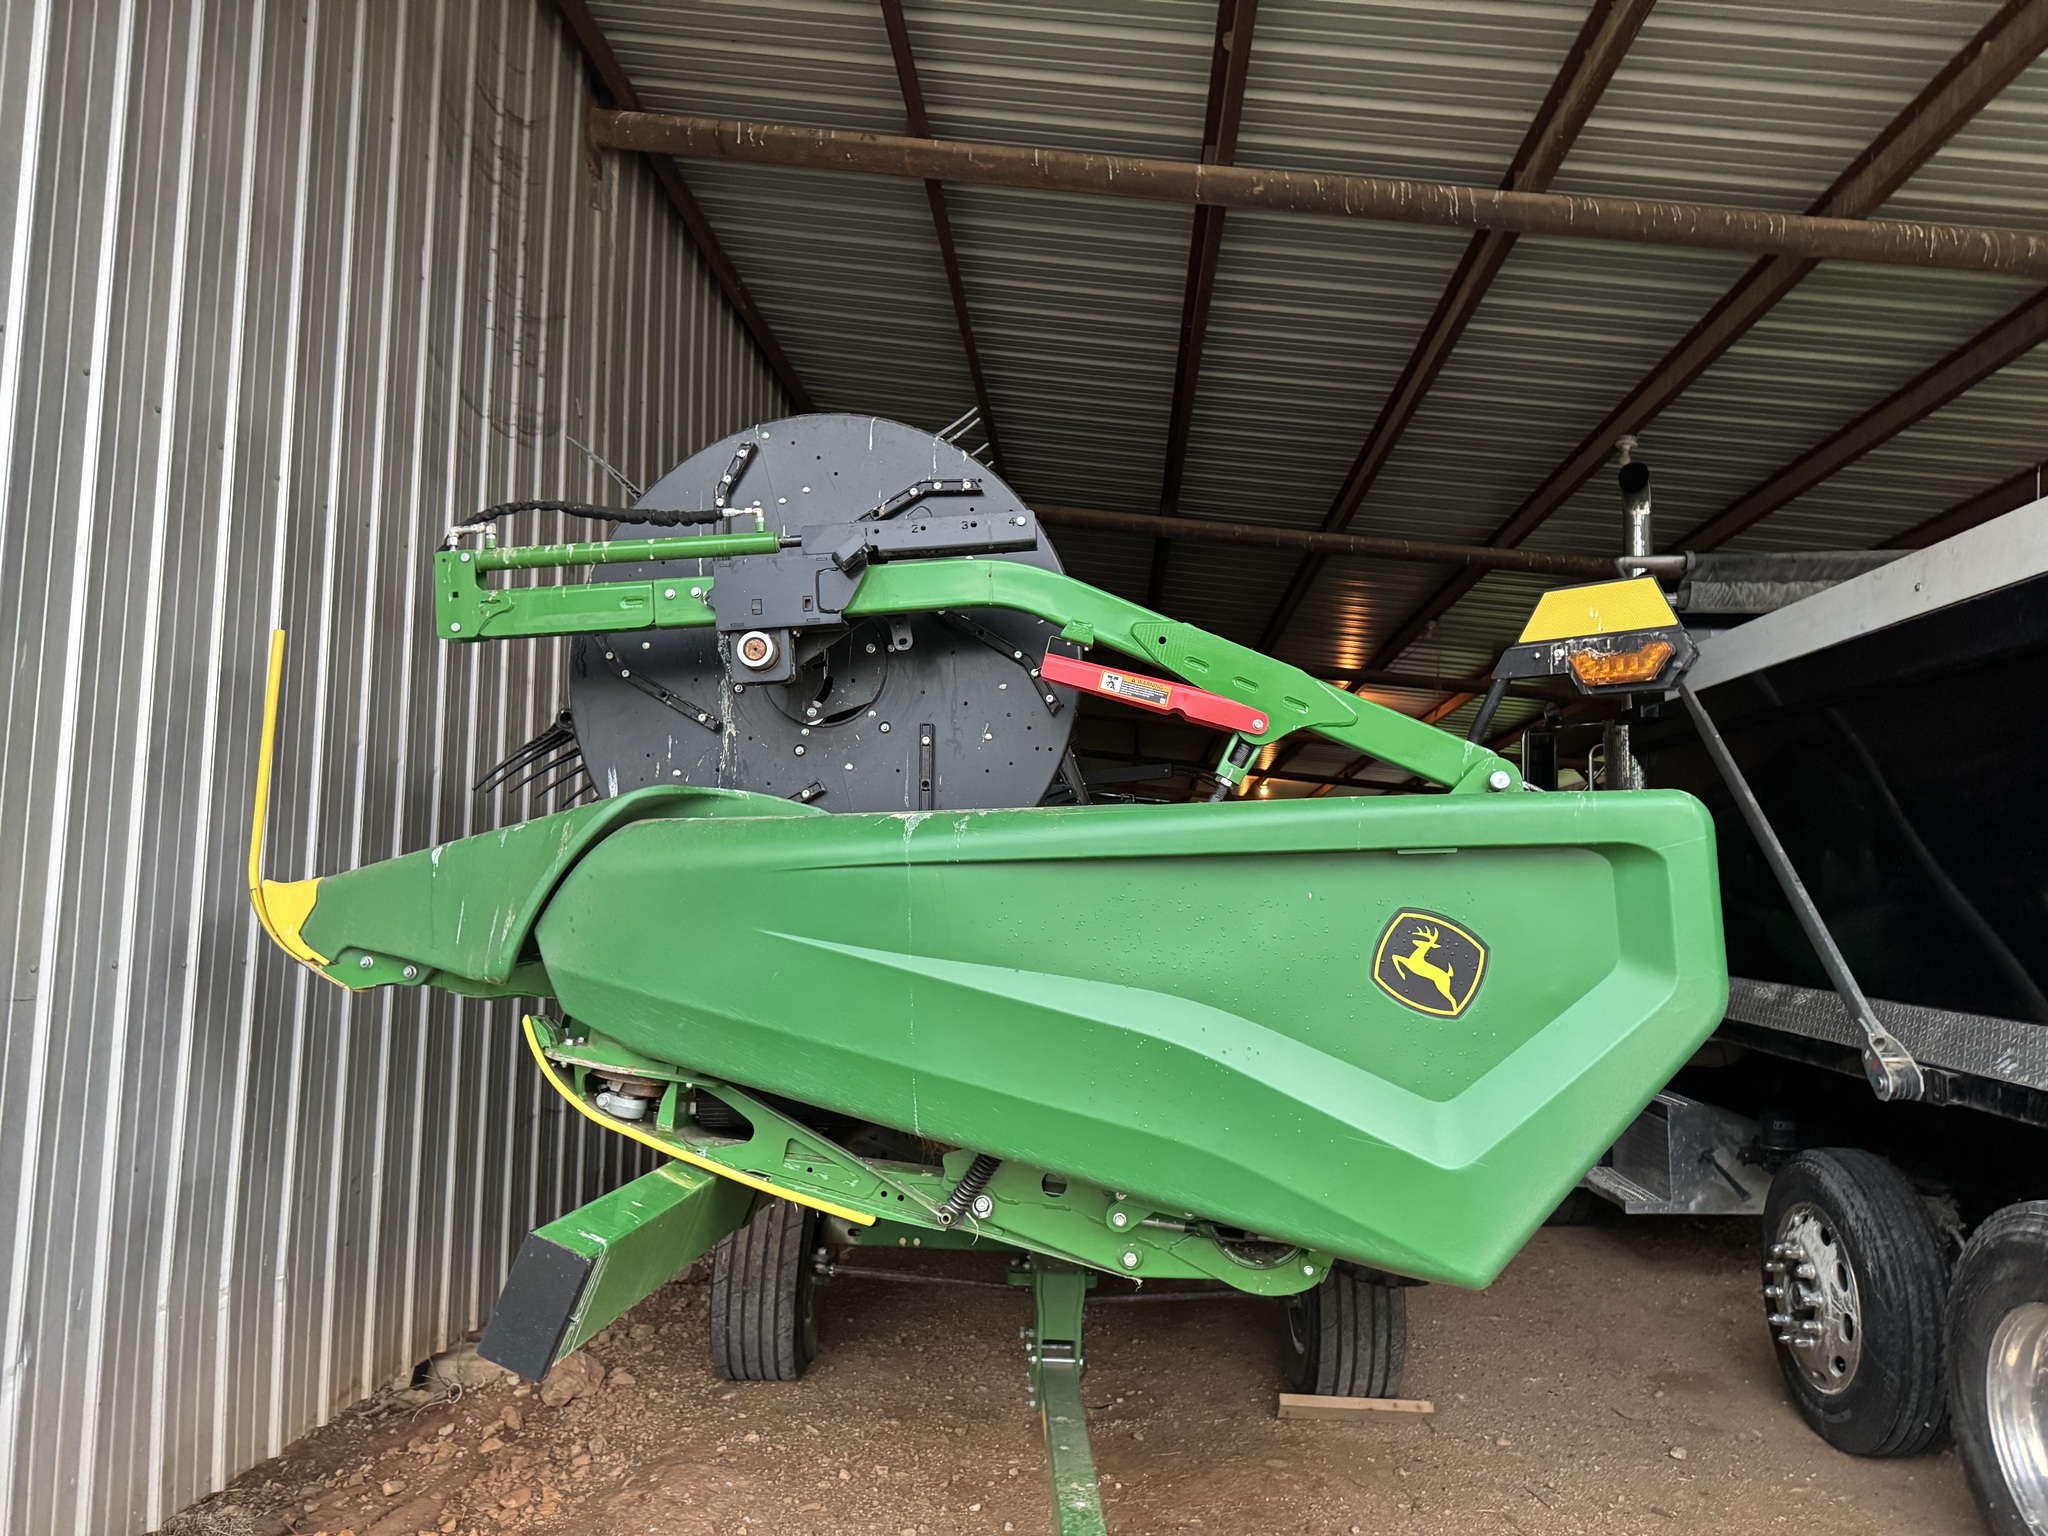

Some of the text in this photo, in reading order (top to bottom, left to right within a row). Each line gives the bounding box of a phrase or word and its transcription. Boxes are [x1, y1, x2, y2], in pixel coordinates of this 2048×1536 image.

[911, 524, 919, 533] 2
[961, 520, 969, 530] 3
[1008, 517, 1016, 526] 4
[1137, 679, 1164, 690] WARNING
